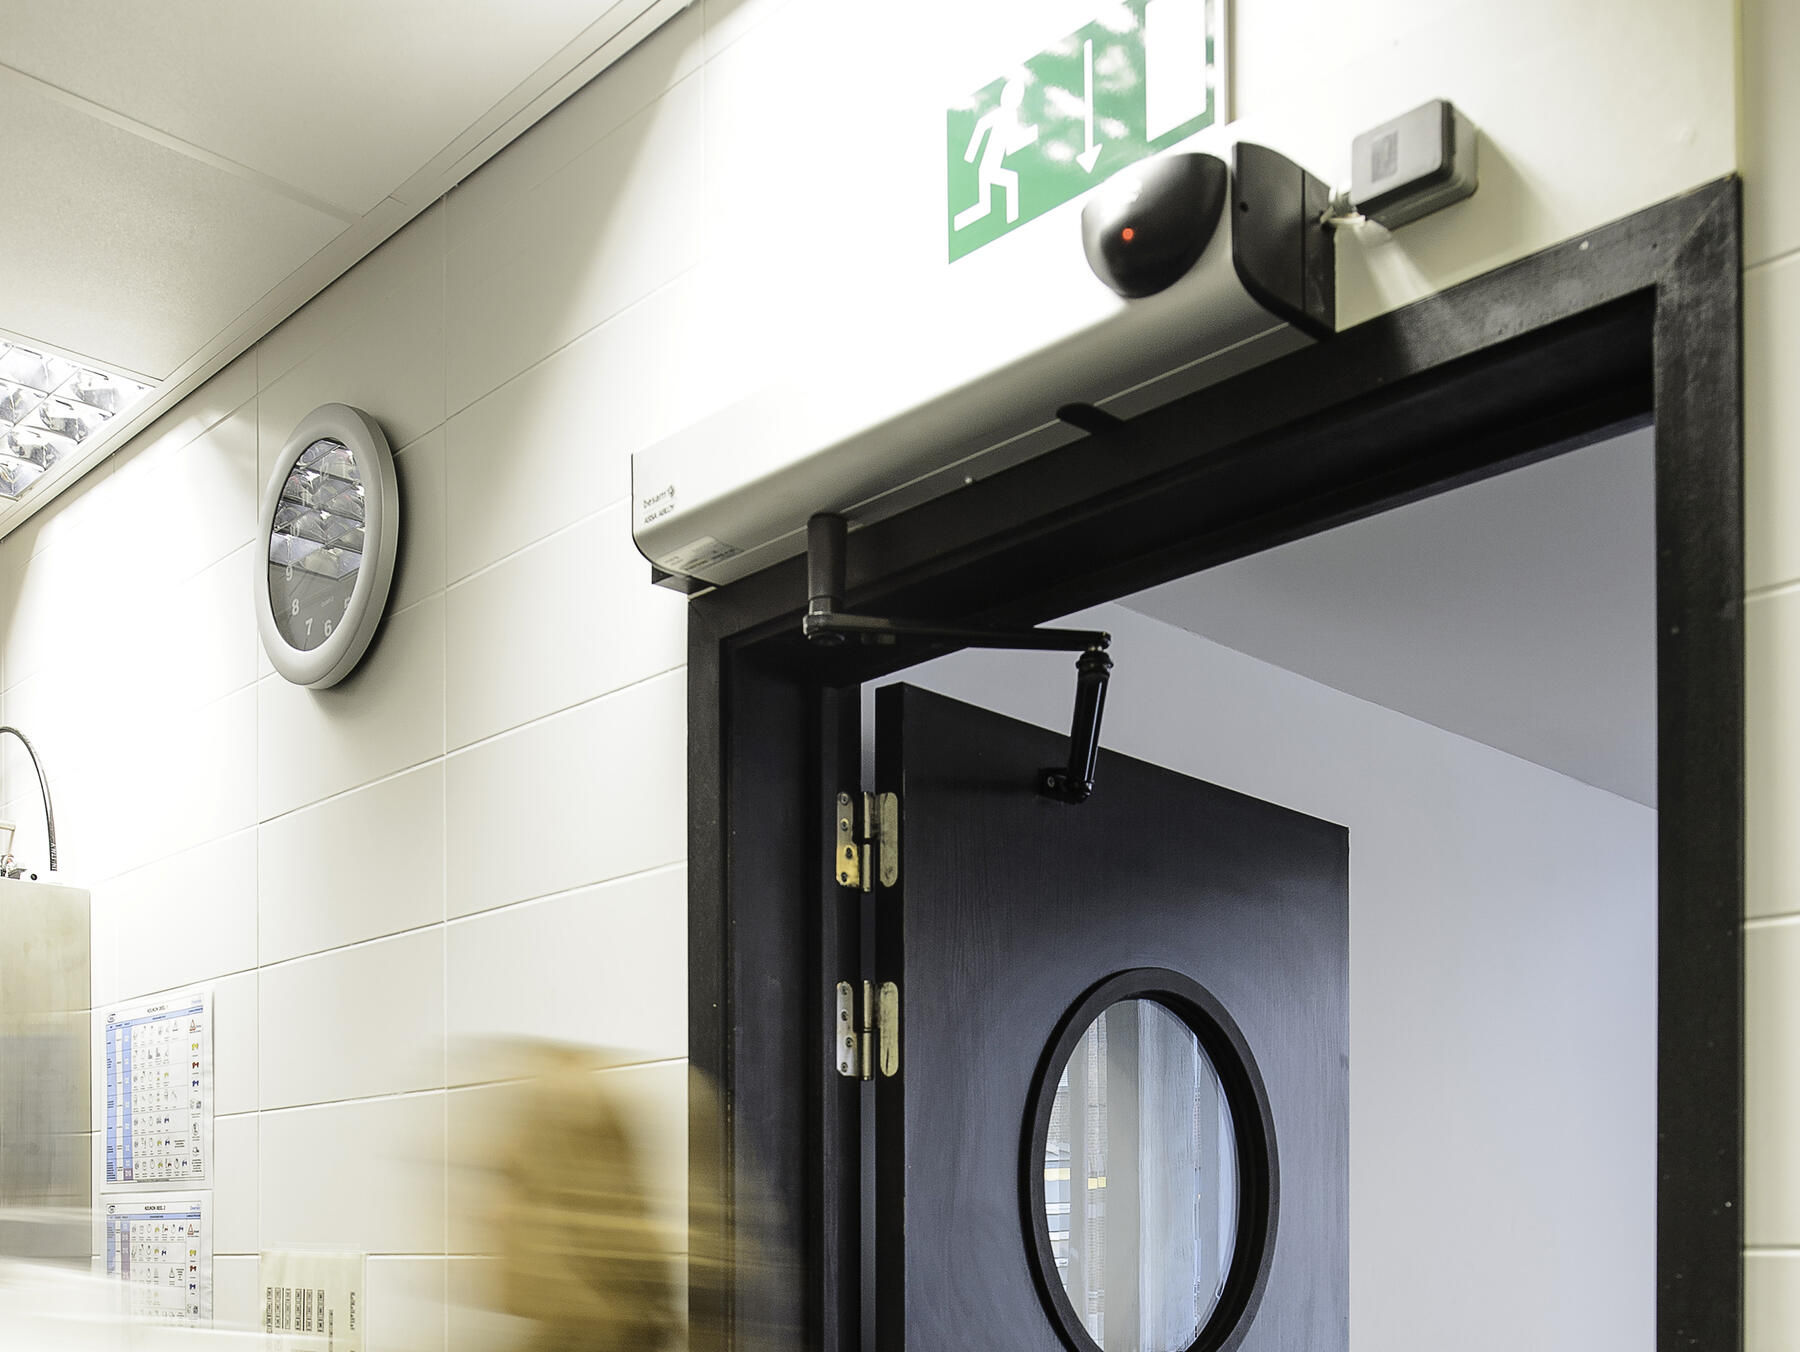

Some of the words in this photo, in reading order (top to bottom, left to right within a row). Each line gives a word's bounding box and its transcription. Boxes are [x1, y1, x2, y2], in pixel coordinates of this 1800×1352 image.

[286, 563, 293, 581] 9
[292, 599, 299, 615] 8
[305, 618, 313, 636] 7
[324, 619, 332, 636] 6
